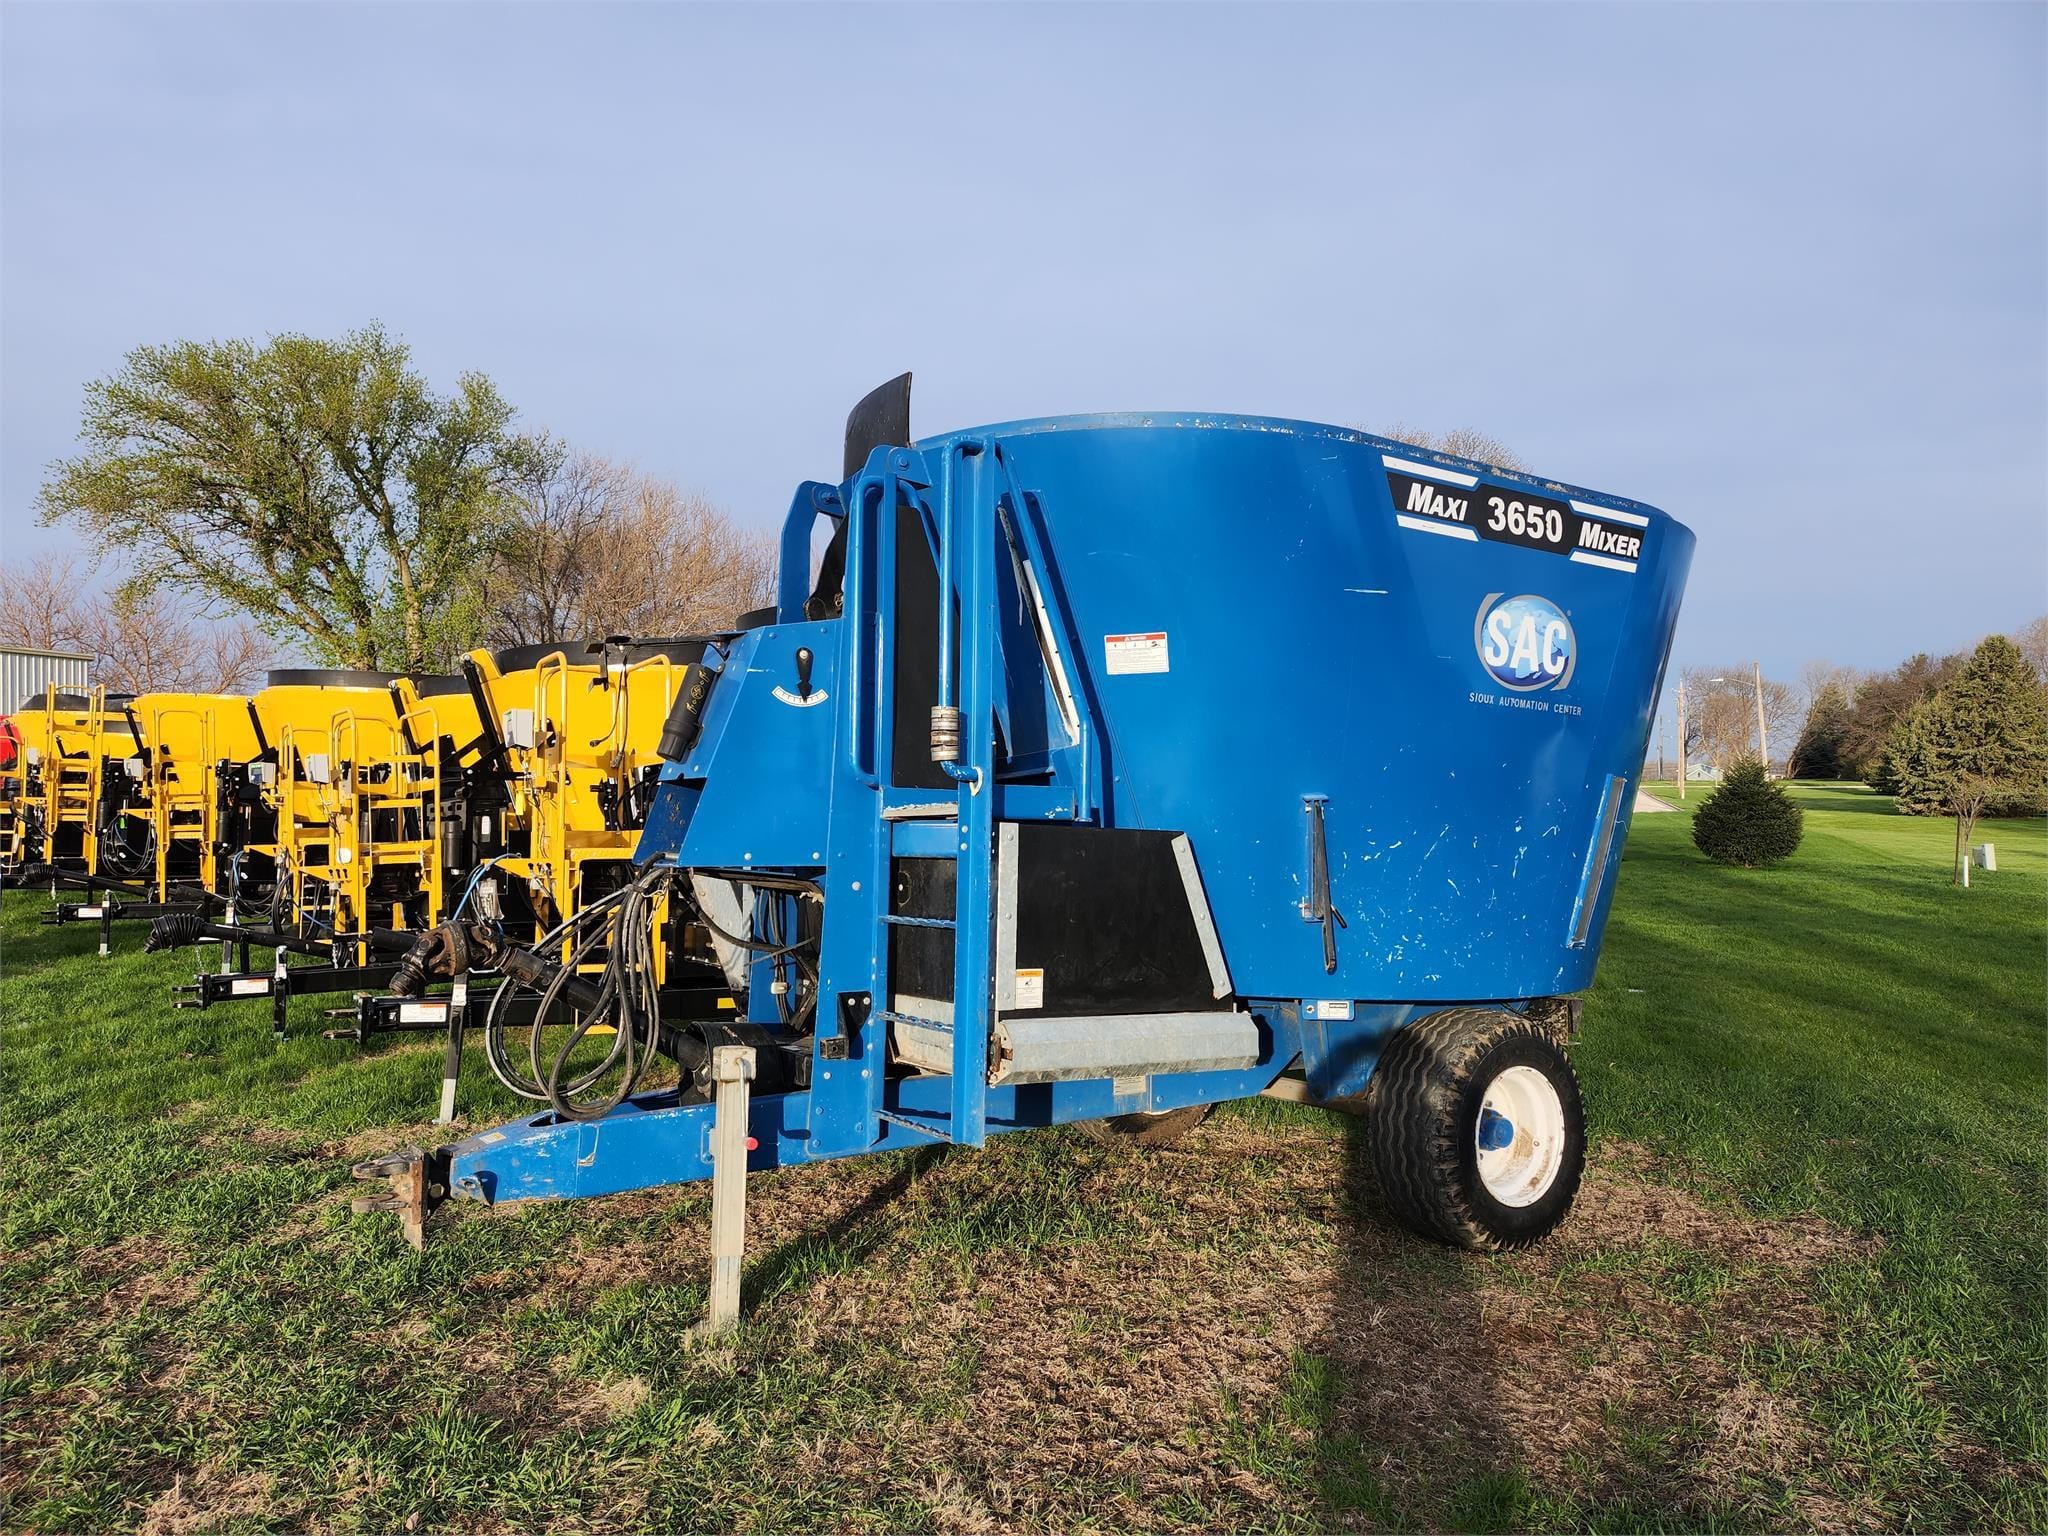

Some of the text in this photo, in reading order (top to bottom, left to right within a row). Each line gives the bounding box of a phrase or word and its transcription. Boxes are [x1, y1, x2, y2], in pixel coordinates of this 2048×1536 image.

[1406, 482, 1640, 558] MAXI 3650 MIXER
[1483, 608, 1568, 675] SAC
[1469, 691, 1582, 716] SIOUX AUTOMATION CENTER
